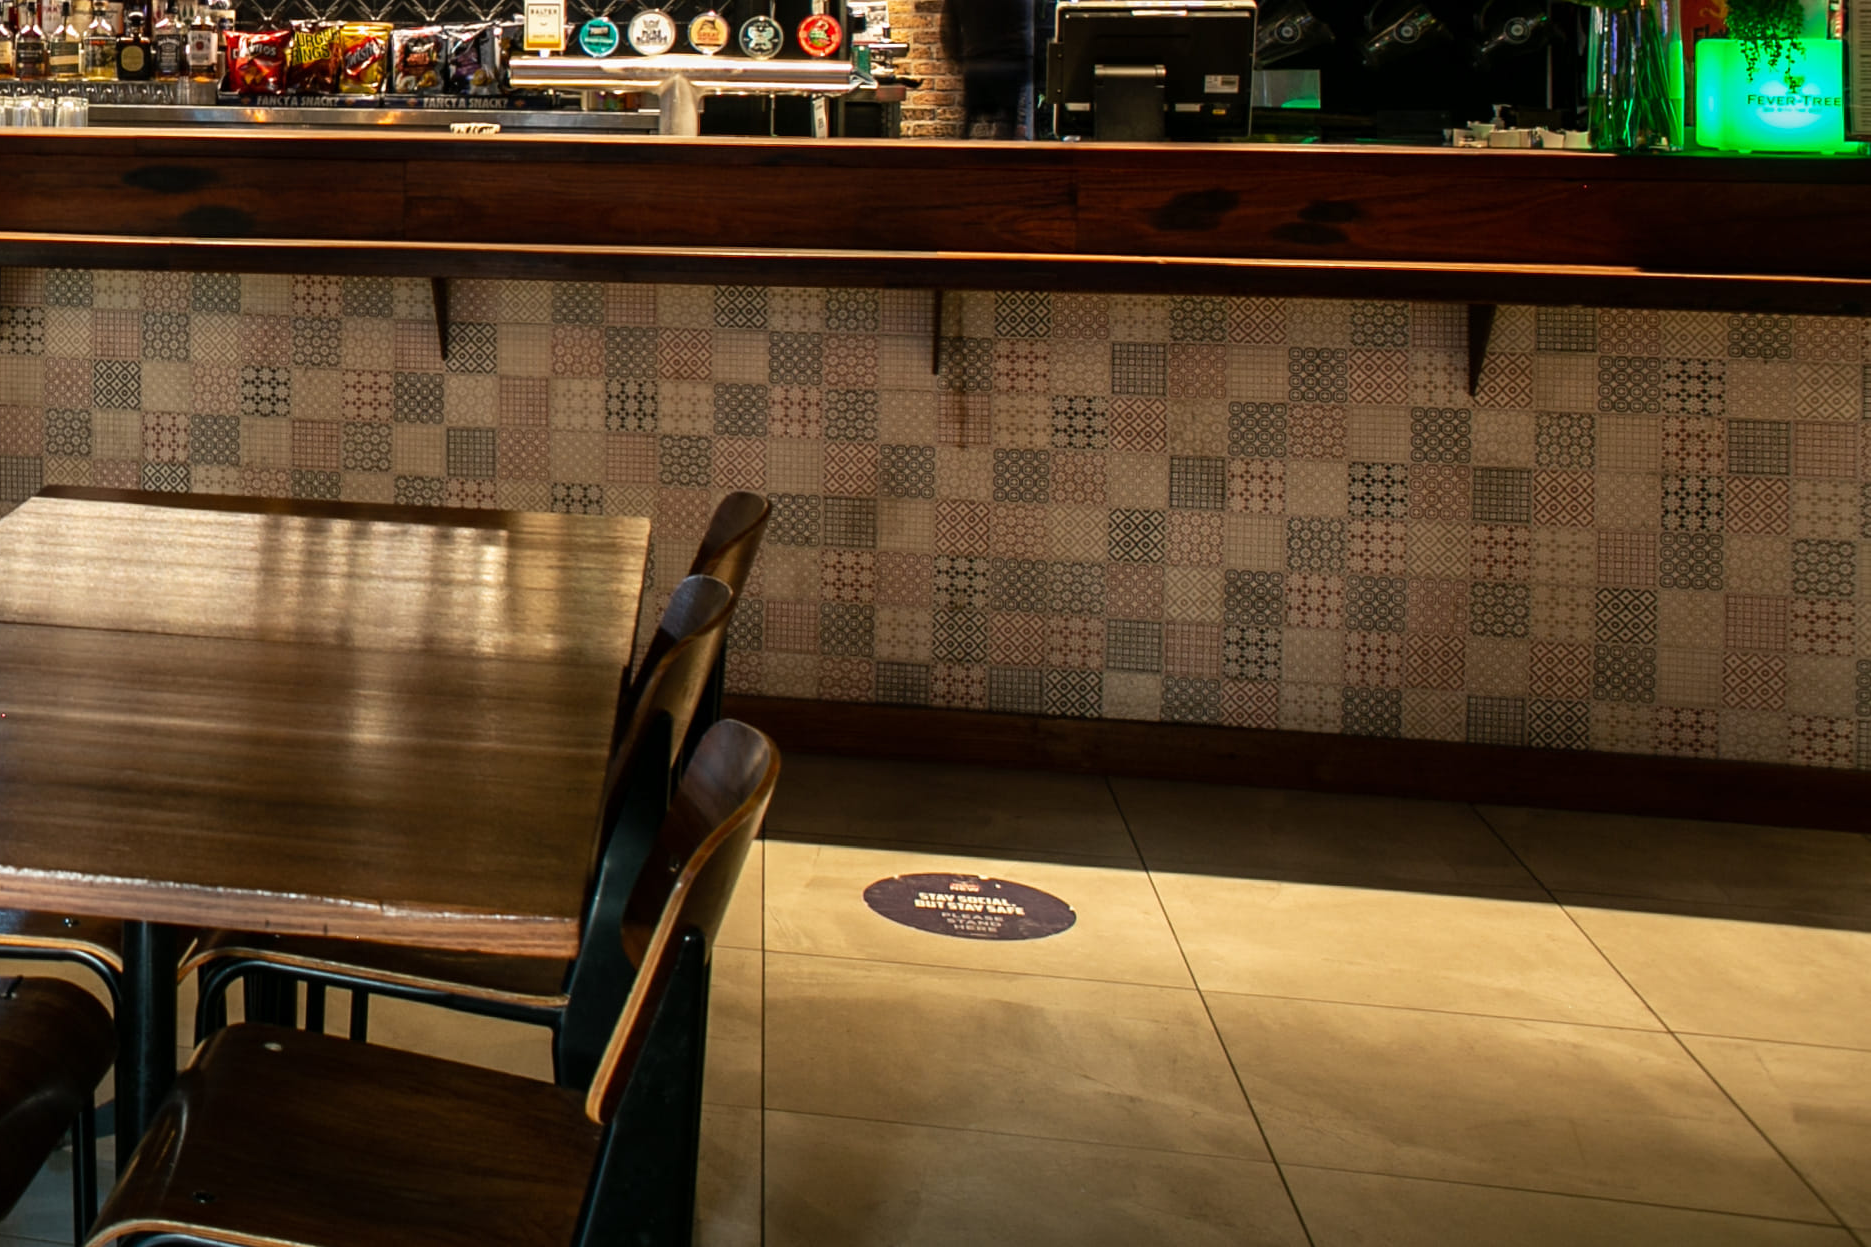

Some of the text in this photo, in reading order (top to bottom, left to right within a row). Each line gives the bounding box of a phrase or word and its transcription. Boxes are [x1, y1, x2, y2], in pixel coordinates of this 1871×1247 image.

[257, 96, 290, 106] FANCY
[1747, 94, 1842, 106] FEVER-TREE
[919, 892, 954, 903] STAY
[914, 899, 1025, 916] BUT STAY SAFE
[941, 912, 1004, 922] PLEASE
[947, 918, 1002, 927] STAND
[954, 924, 998, 933] HERE
